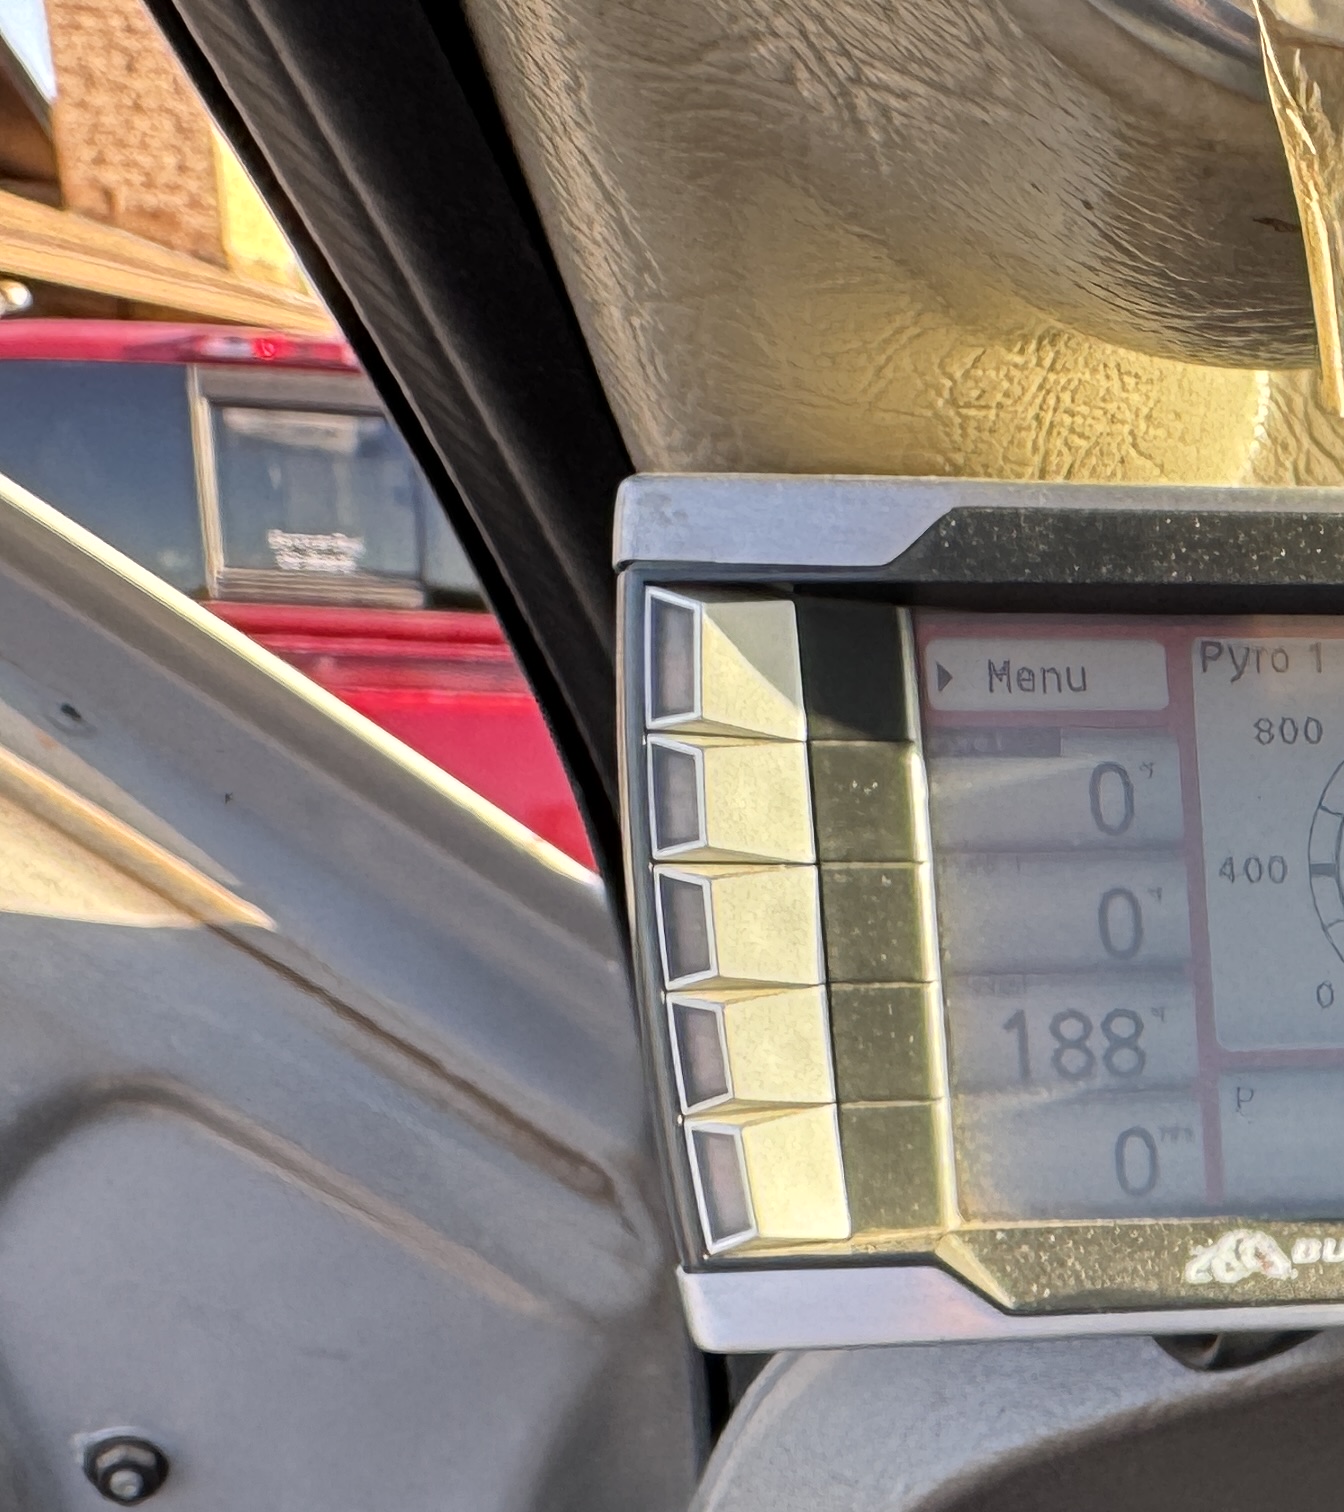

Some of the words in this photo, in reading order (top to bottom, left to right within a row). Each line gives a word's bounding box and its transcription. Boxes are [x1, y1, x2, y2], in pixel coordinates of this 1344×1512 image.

[987, 658, 1088, 695] Menu
[1201, 640, 1289, 683] Pyro
[1309, 642, 1322, 673] 1
[1253, 716, 1324, 746] 800
[1088, 761, 1135, 837] 0
[1219, 855, 1288, 884] 400
[1098, 887, 1144, 961] 0
[1316, 981, 1335, 1009] 0
[1002, 1007, 1147, 1081] 188
[1236, 1086, 1254, 1110] P
[1114, 1126, 1161, 1197] 0
